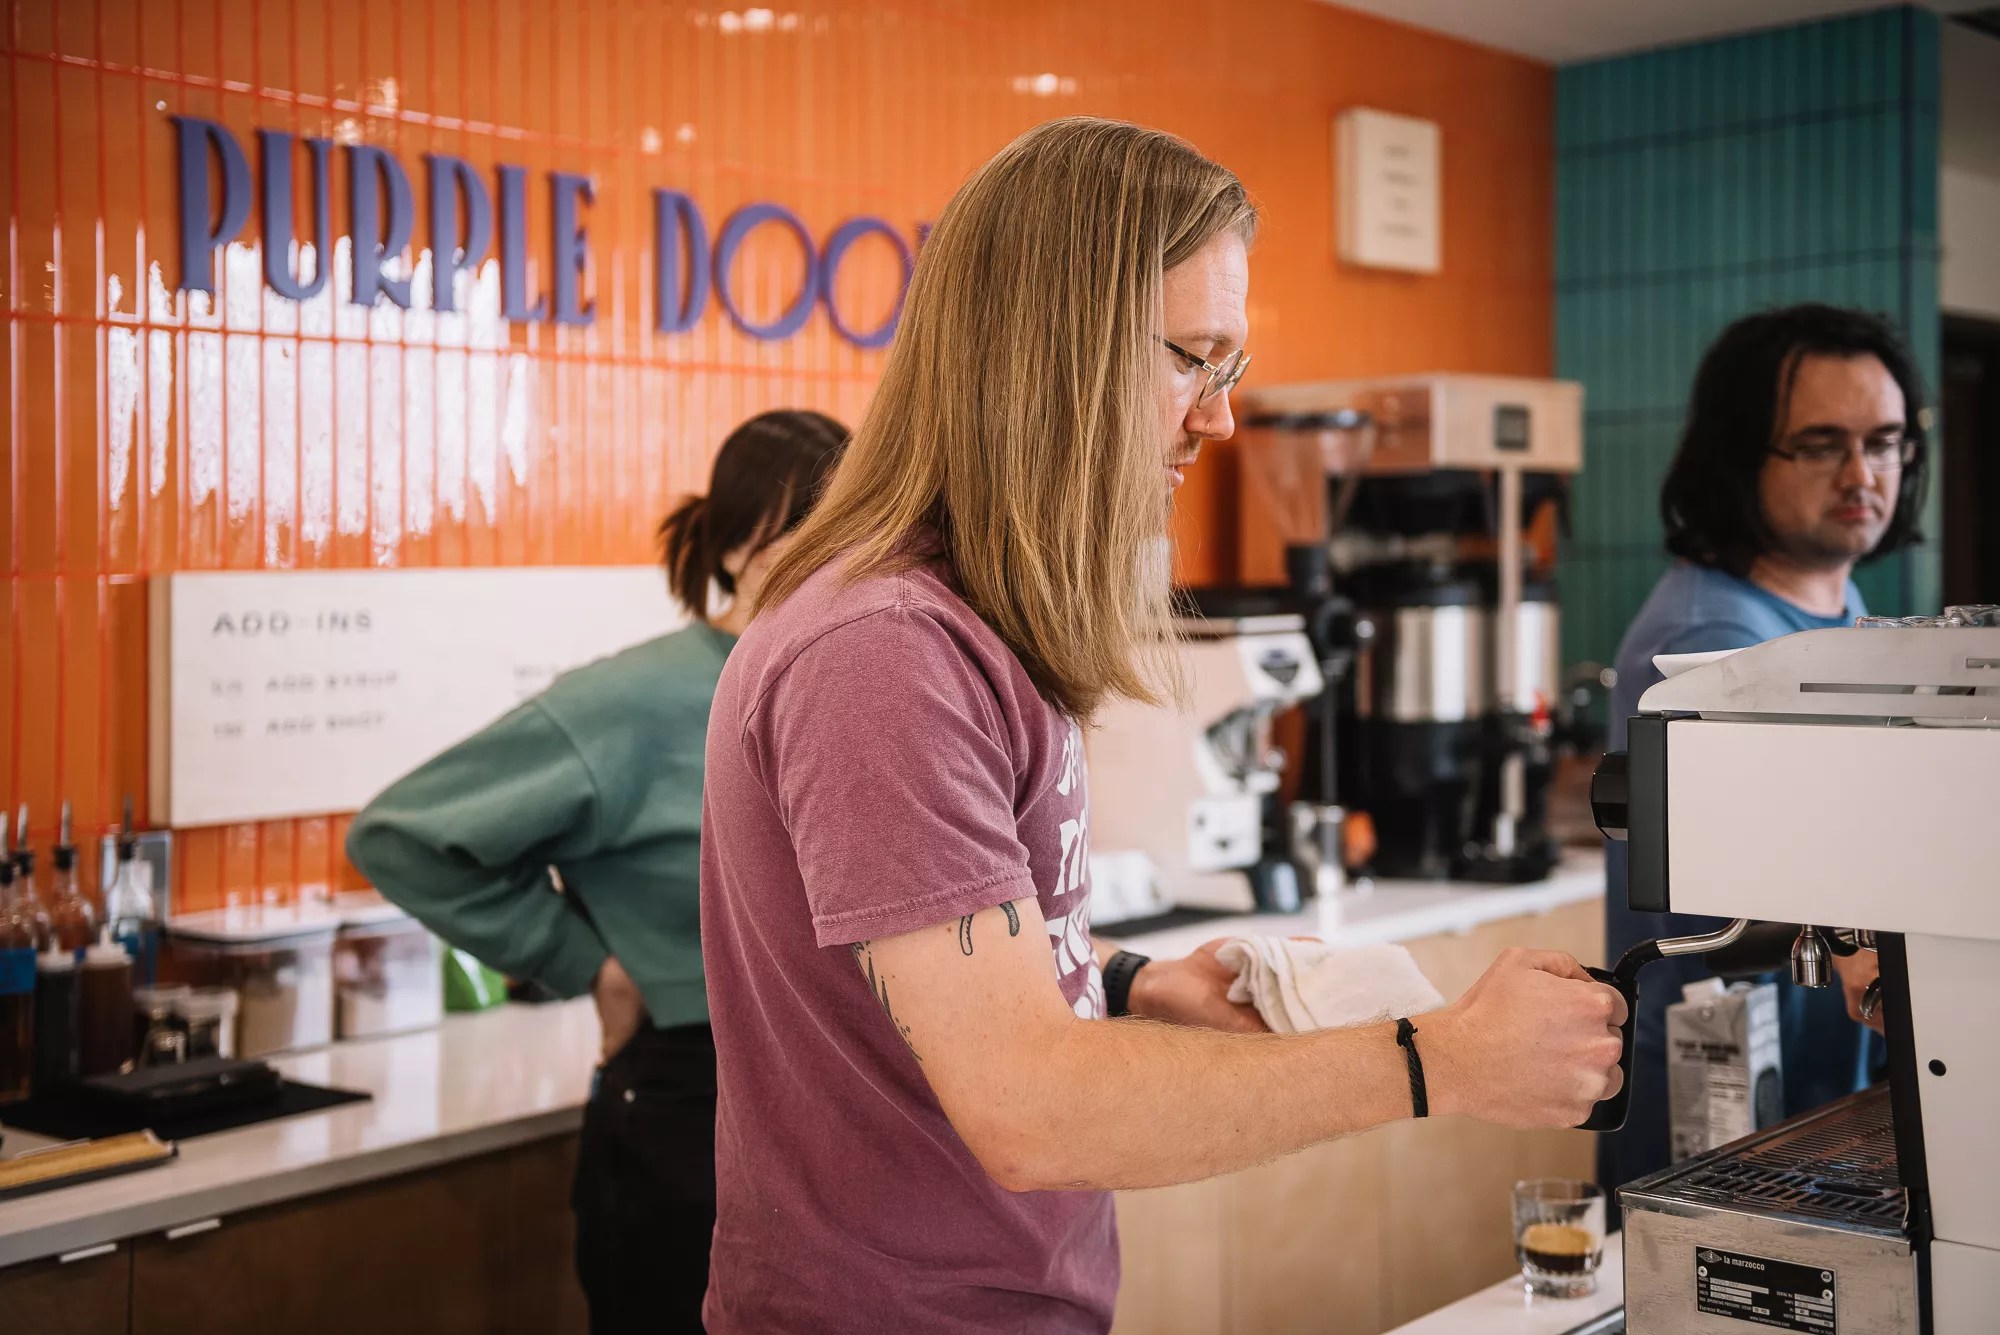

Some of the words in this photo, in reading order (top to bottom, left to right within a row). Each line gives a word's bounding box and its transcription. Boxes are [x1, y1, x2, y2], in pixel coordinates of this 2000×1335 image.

[171, 114, 596, 326] PURPLE
[653, 188, 933, 349] DOO
[1724, 1256, 1730, 1264] la
[1731, 1258, 1764, 1270] marzocco
